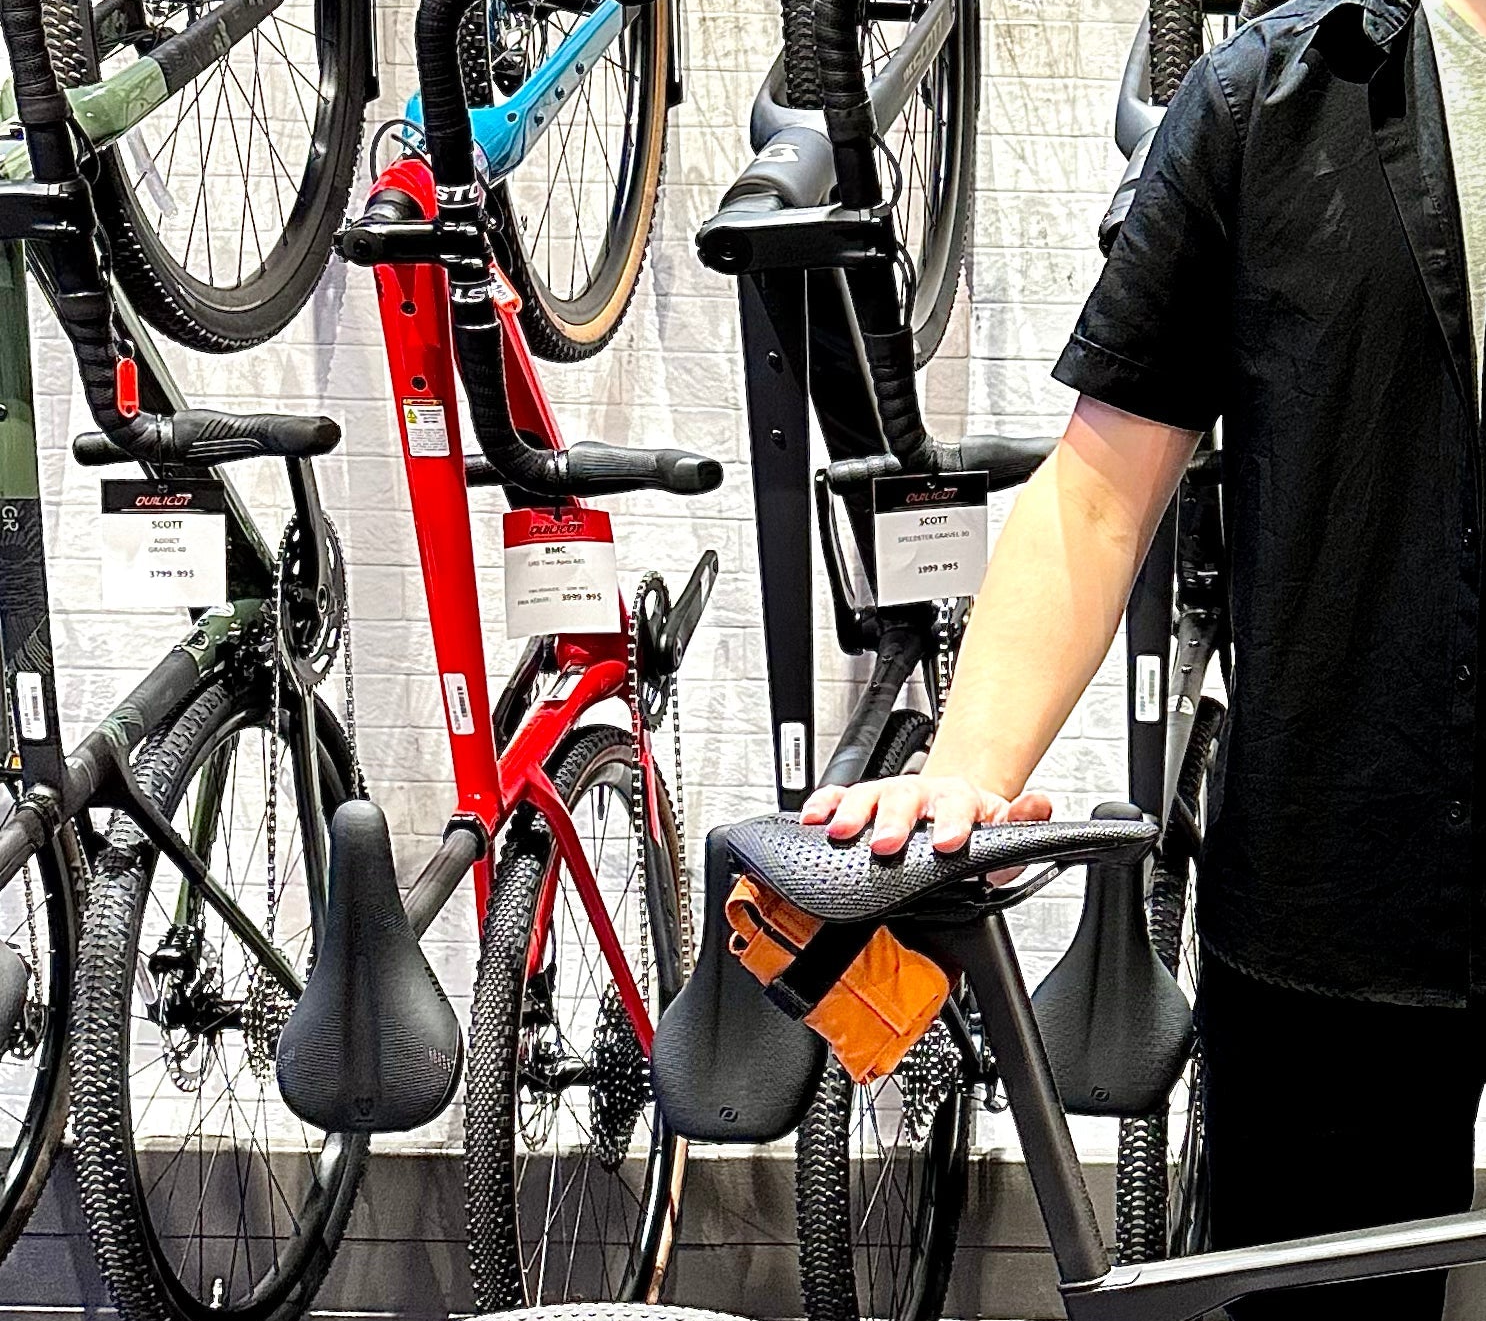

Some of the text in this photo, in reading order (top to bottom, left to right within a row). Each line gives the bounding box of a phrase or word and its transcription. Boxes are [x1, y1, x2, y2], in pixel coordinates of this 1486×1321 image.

[135, 495, 191, 507] QUILICOT
[906, 490, 958, 503] QUILICOT
[151, 520, 184, 529] SCOTT
[919, 515, 949, 526] SCOTT
[545, 546, 567, 555] BMC
